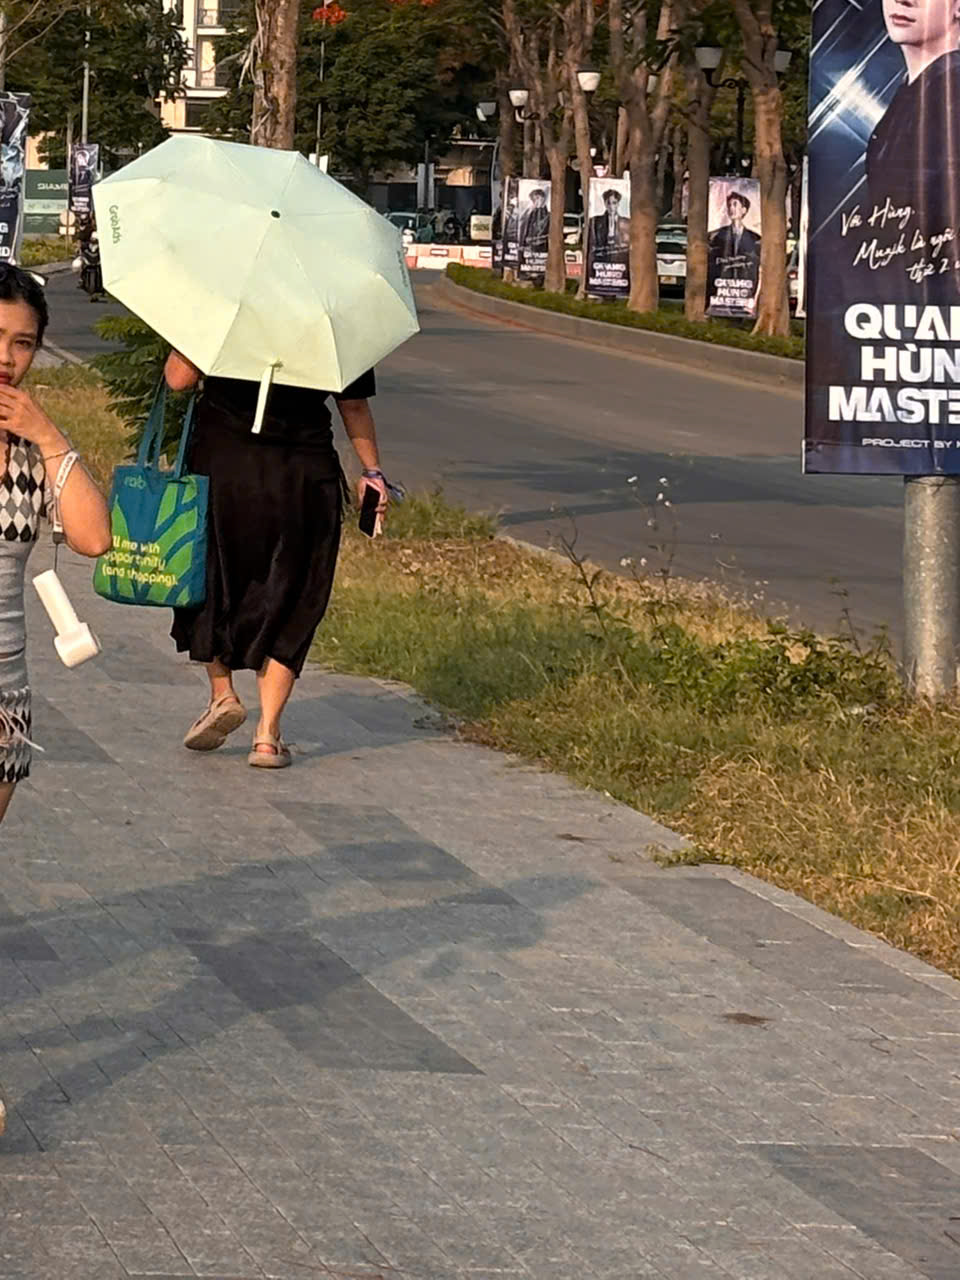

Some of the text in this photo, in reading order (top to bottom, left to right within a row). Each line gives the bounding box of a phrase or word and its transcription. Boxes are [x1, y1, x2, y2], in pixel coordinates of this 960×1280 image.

[860, 343, 960, 383] HÙN
[862, 438, 930, 448] PROJECT
[933, 440, 952, 449] BY
